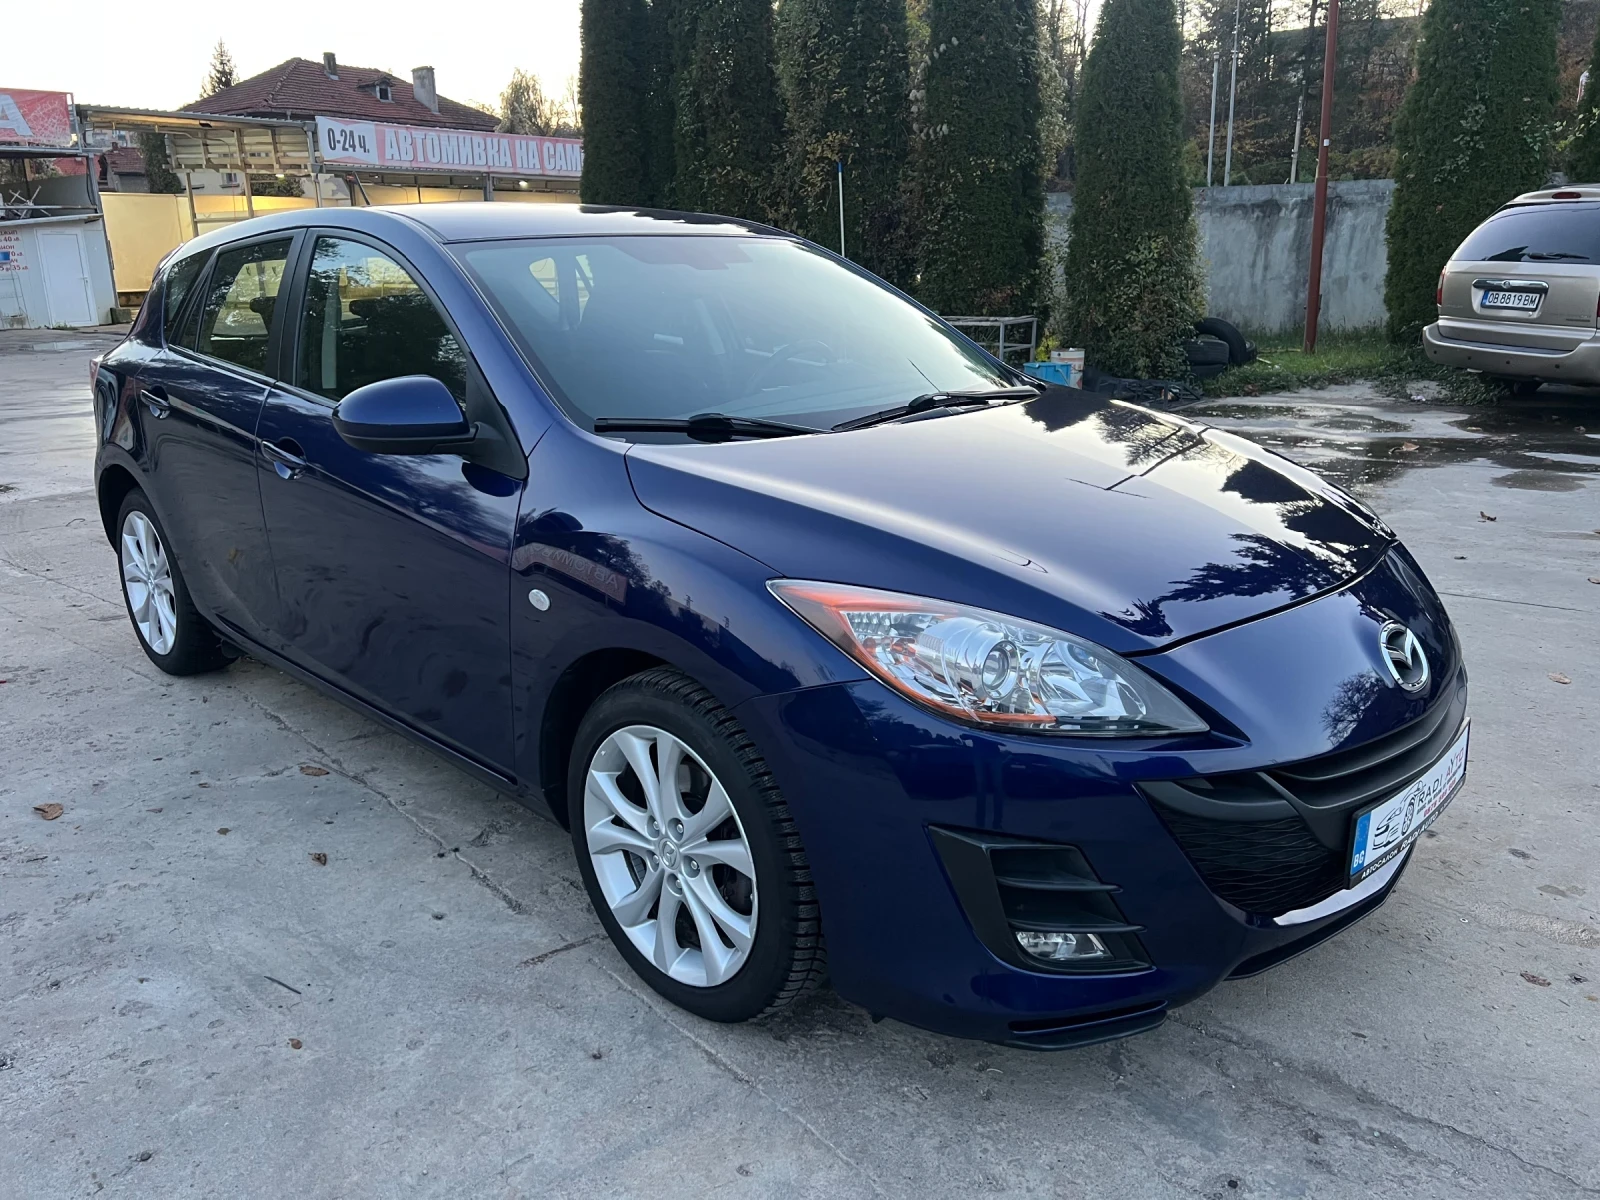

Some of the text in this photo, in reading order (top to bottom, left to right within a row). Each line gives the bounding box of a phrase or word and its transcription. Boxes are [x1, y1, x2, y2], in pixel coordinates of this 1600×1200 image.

[327, 128, 356, 152] 0-24
[385, 129, 513, 168] АВТОМИВКА
[515, 139, 541, 169] НА
[543, 141, 584, 171] САМ
[1353, 850, 1365, 868] BG
